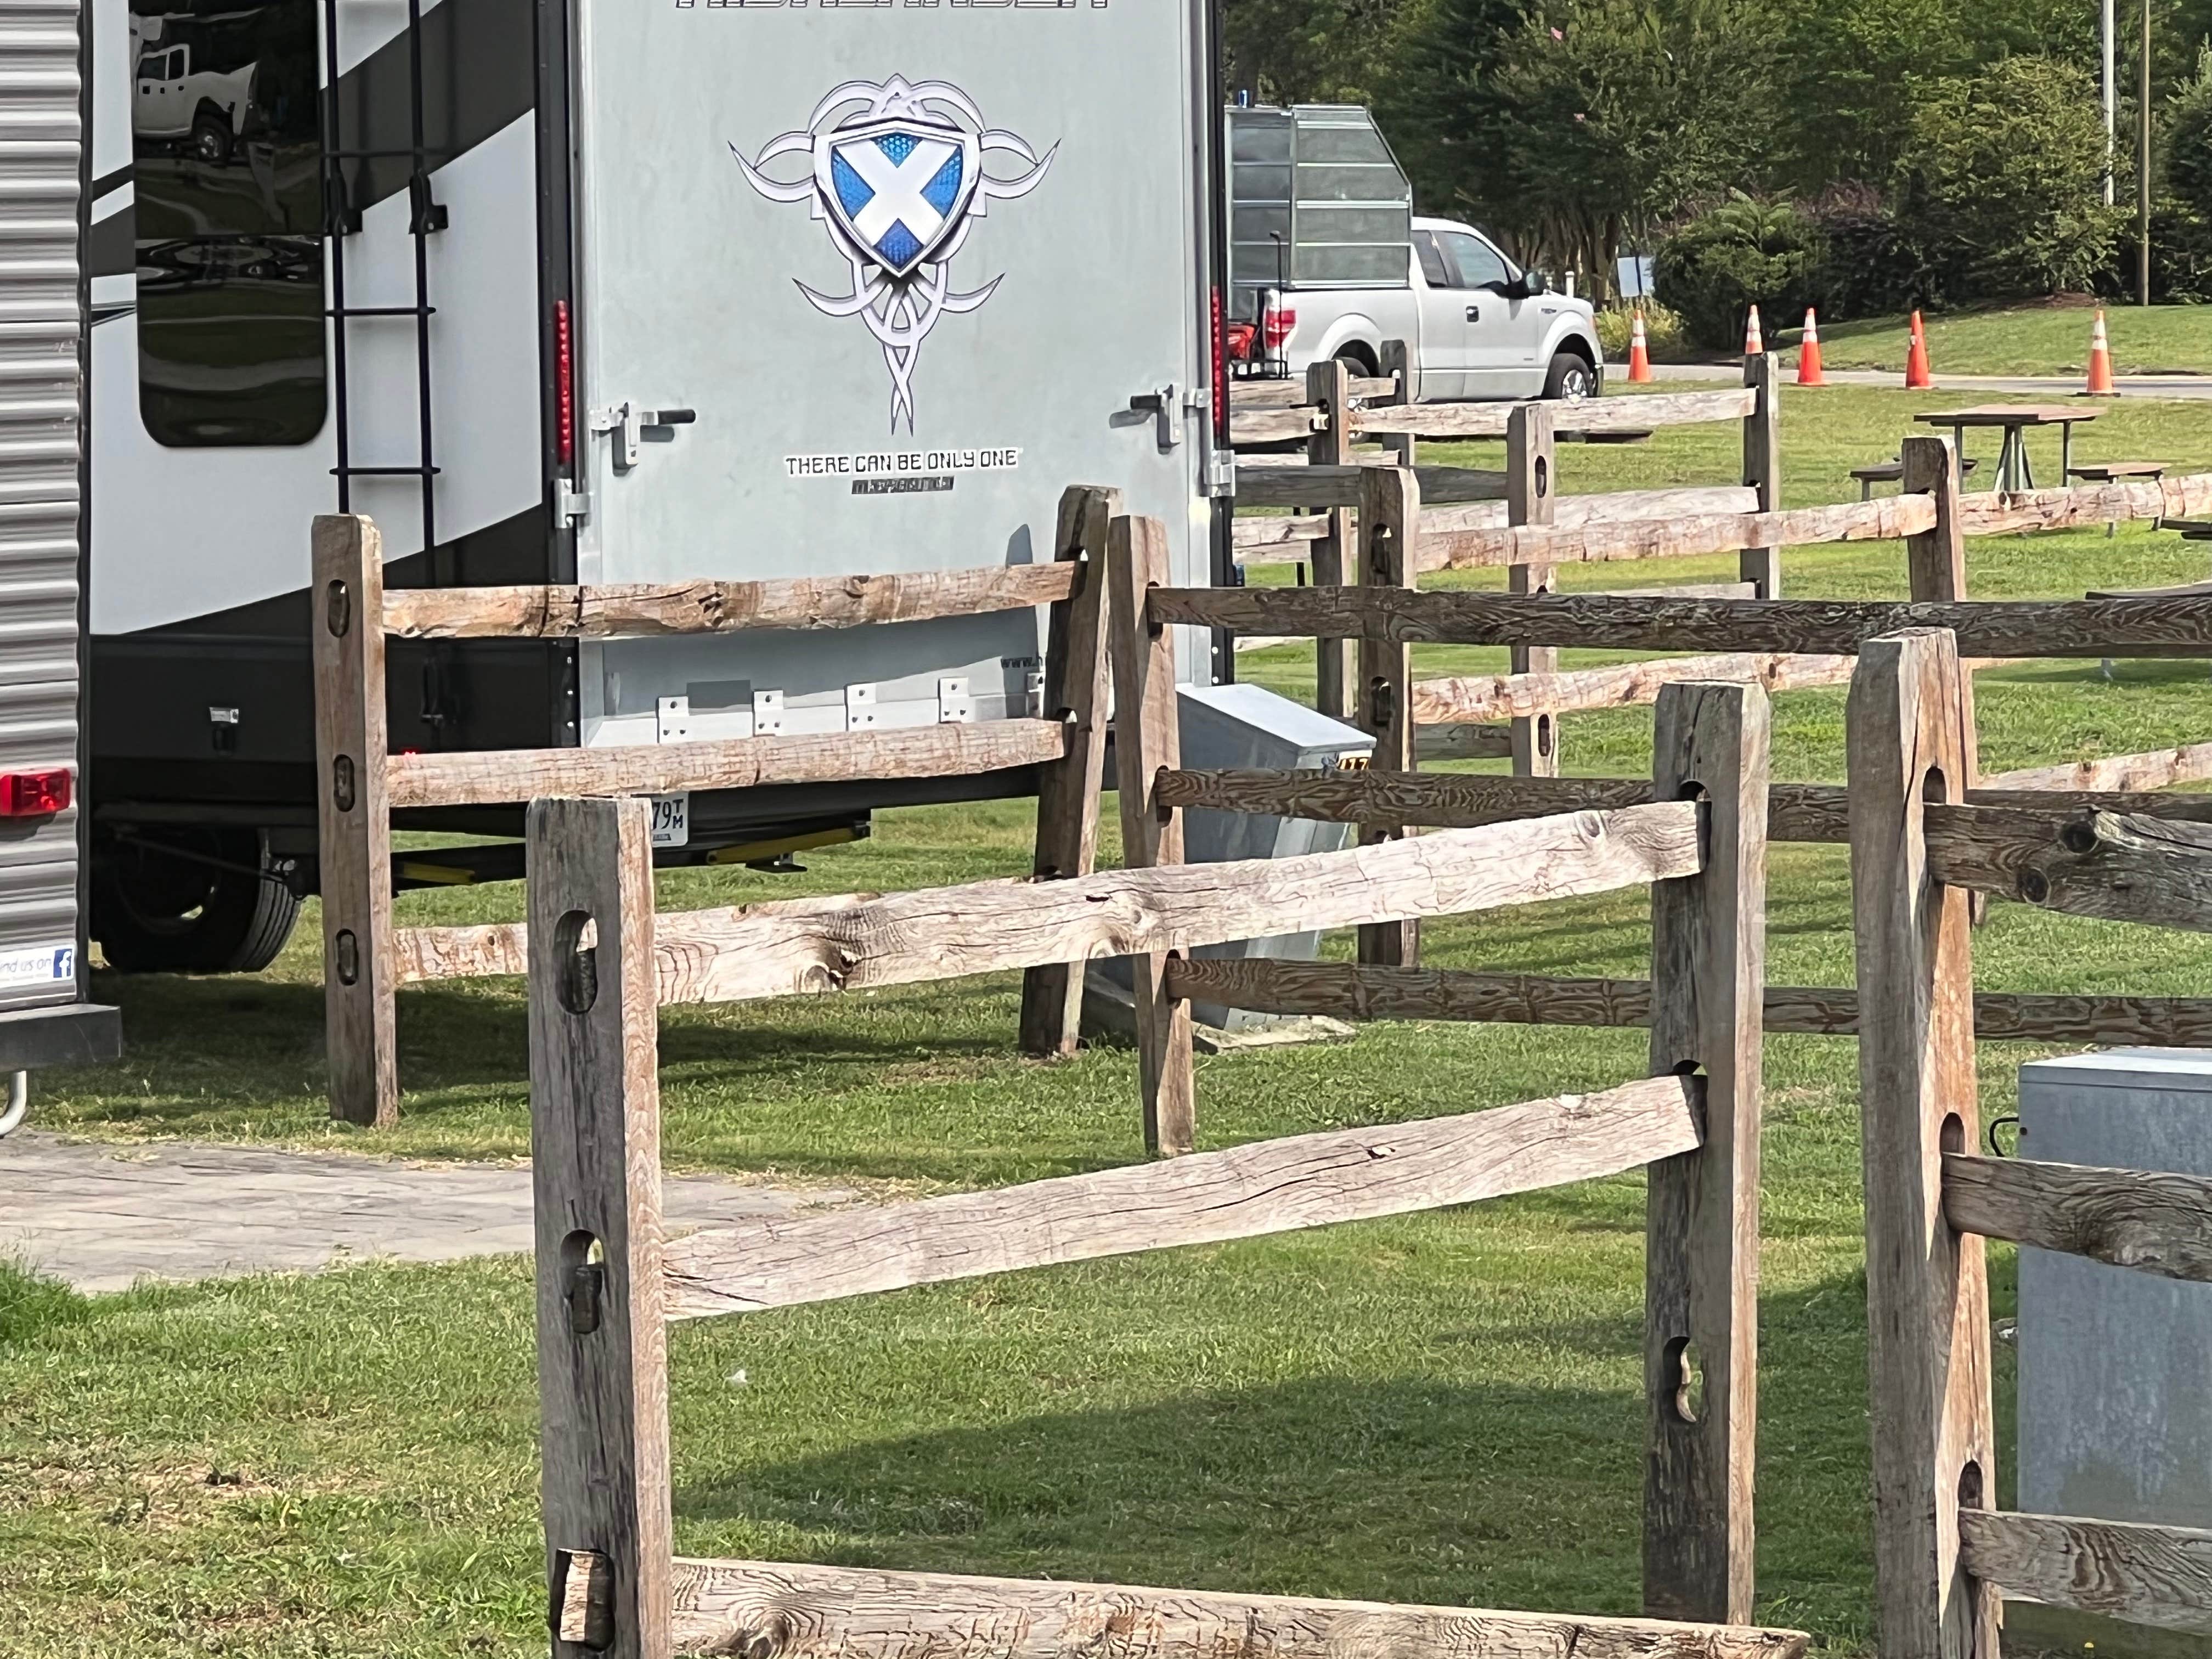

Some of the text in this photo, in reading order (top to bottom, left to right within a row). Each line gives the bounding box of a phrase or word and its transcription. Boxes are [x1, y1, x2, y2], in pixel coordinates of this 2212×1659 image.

[786, 450, 1017, 475] THERE CAN BE ONLY ONE
[0, 957, 18, 973] nd
